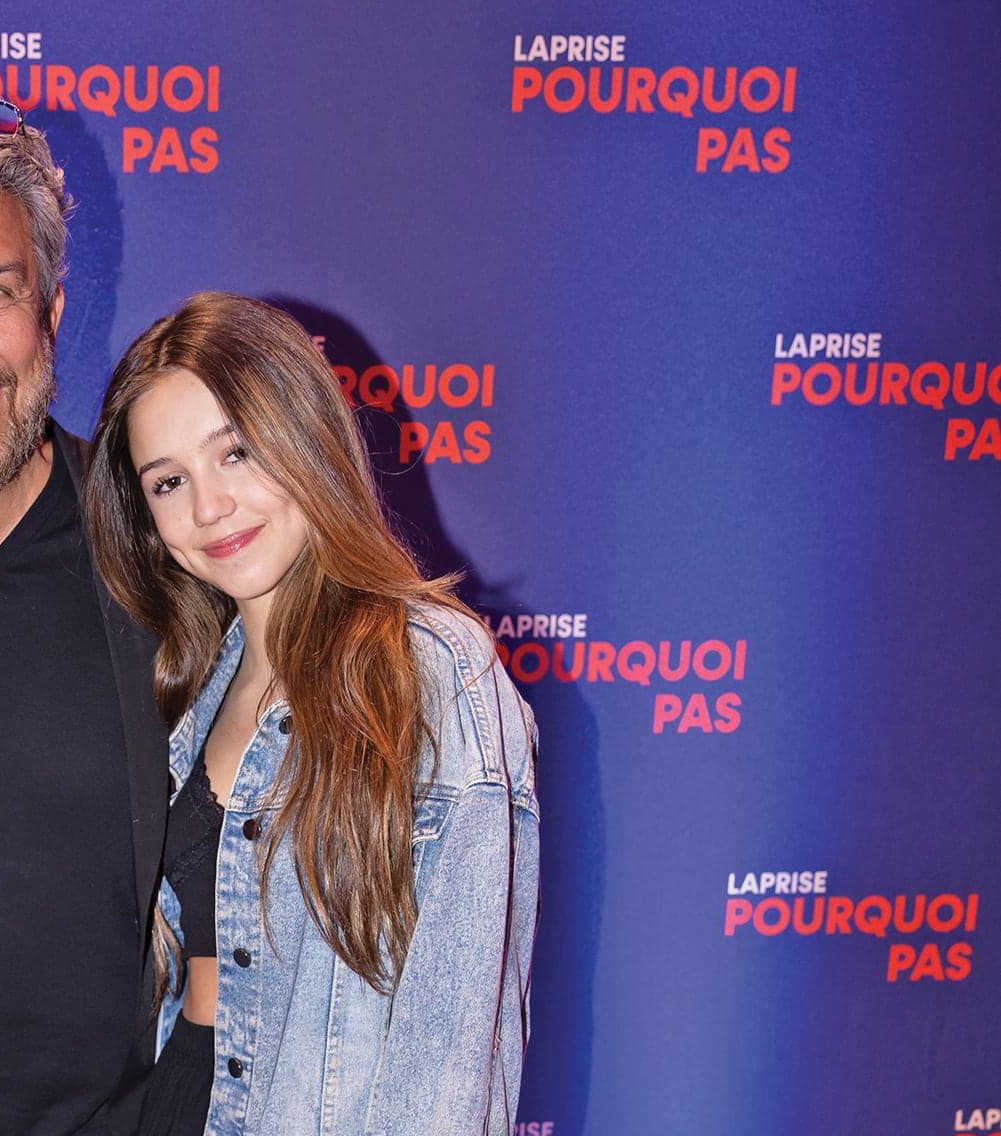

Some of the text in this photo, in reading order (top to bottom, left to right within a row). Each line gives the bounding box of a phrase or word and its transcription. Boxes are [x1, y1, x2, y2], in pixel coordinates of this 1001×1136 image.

[515, 36, 625, 61] LAPRISE
[512, 67, 796, 117] POURQUOI
[123, 127, 218, 173] PAS
[696, 128, 790, 172] PAS
[775, 334, 881, 358] LAPRISE
[331, 364, 494, 413] RQUOI
[772, 362, 1001, 409] POURQU
[400, 421, 490, 464] PAS
[945, 418, 1001, 460] PA
[654, 693, 741, 733] PAS
[728, 872, 826, 894] LAPRISE
[725, 894, 978, 937] POURQUOI
[888, 943, 971, 981] PAS
